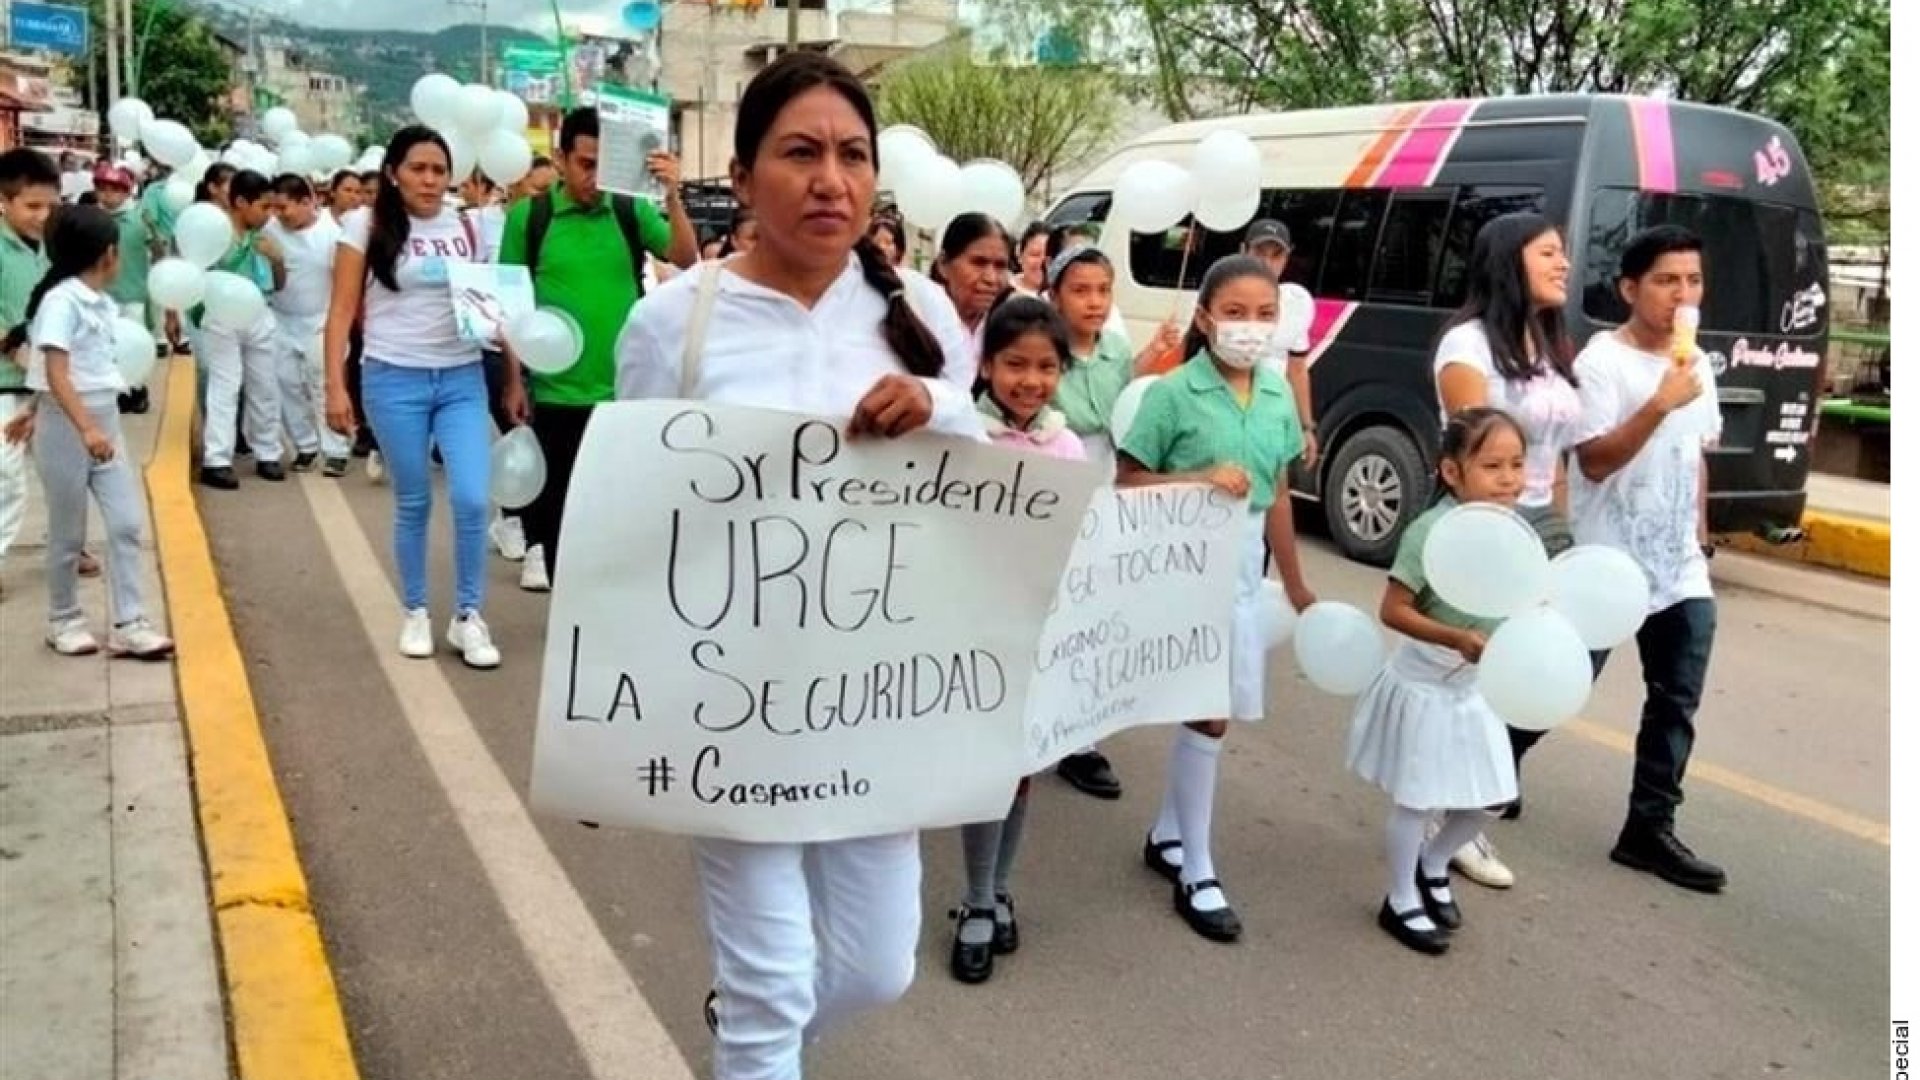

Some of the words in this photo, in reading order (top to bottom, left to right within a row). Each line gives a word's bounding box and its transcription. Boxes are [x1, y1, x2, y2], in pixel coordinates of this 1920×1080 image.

[410, 237, 468, 257] ERO
[791, 420, 1060, 519] Presidente
[667, 509, 921, 632] URGE
[1110, 540, 1208, 585] TOCAN
[566, 625, 642, 722] LA
[691, 640, 1007, 735] SEGURIDAD
[692, 745, 871, 807] Gasparcito
